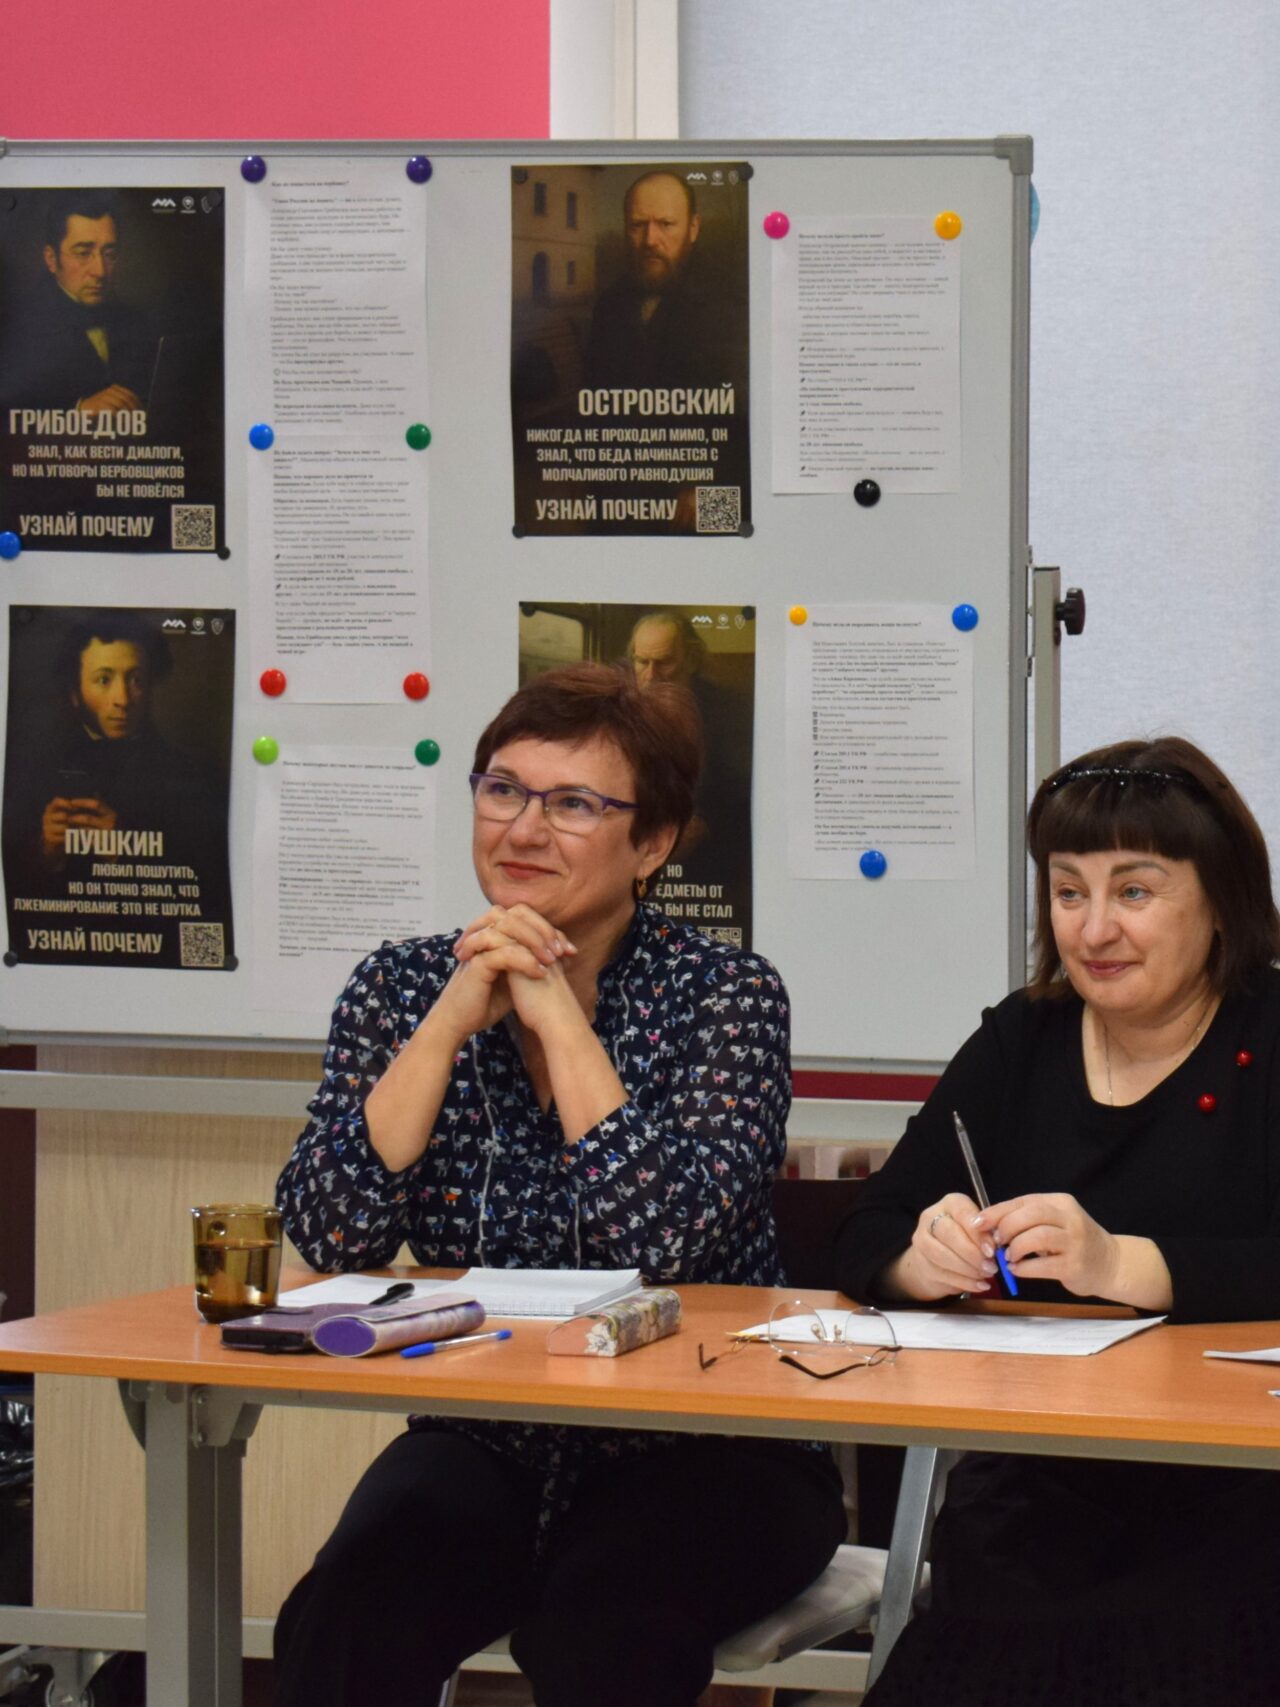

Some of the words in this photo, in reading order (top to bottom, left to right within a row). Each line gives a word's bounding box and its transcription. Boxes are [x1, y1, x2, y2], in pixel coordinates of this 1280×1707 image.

[578, 382, 735, 416] ОСТРОВСКИЙ
[9, 409, 147, 440] ГРИБОЕДОВ
[526, 429, 582, 444] НИКОГДА
[584, 429, 599, 442] НЕ
[601, 428, 666, 444] ПРОХОДИЛ
[669, 428, 709, 443] МИМО,
[712, 428, 728, 441] ОН
[28, 445, 62, 460] ЗНАЛ,
[64, 446, 87, 458] КАК
[90, 446, 124, 459] ВЕСТИ
[126, 446, 184, 461] ДИАЛОГИ,
[537, 448, 572, 463] ЗНАЛ,
[574, 449, 596, 462] ЧТО
[598, 448, 632, 463] БЕДА
[634, 447, 708, 461] НАЧИНАЕТСЯ
[710, 448, 718, 461] С
[12, 464, 27, 477] НО
[29, 464, 44, 476] НА
[46, 464, 98, 478] УГОВОРЫ
[100, 465, 185, 479] ВЕРБОВЩИКОВ
[542, 468, 628, 482] МОЛЧАЛИВОГО
[629, 467, 714, 483] РАВНОДУШИЯ
[96, 484, 114, 497] БЫ
[116, 485, 130, 497] НЕ
[132, 482, 185, 498] ПОВЁЛСЯ
[536, 495, 597, 520] УЗНАЙ
[602, 499, 678, 520] ПОЧЕМУ
[20, 511, 77, 536] УЗНАЙ
[82, 516, 154, 538] ПОЧЕМУ
[65, 828, 163, 857] ПУШКИН
[92, 863, 133, 878] ЛЮБИЛ
[136, 865, 198, 881] ПОШУТИТЬ,
[667, 864, 683, 878] НО
[68, 881, 84, 895] НО
[86, 882, 101, 895] ОН
[103, 882, 138, 896] ТОЧНО
[141, 884, 176, 899] ЗНАЛ,
[178, 884, 200, 898] ЧТО
[655, 884, 707, 899] ЕДМЕТЫ
[709, 885, 724, 899] ОТ
[14, 898, 119, 914] ЛЖЕМИНИРОВАНИЕ
[121, 902, 142, 915] ЭТО
[145, 903, 158, 916] НЕ
[161, 903, 202, 917] ШУТКА
[665, 903, 683, 916] БЫ
[686, 904, 701, 918] НЕ
[703, 904, 733, 919] СТАЛ
[28, 928, 86, 951] УЗНАЙ
[90, 932, 163, 954] ПОЧЕМУ
